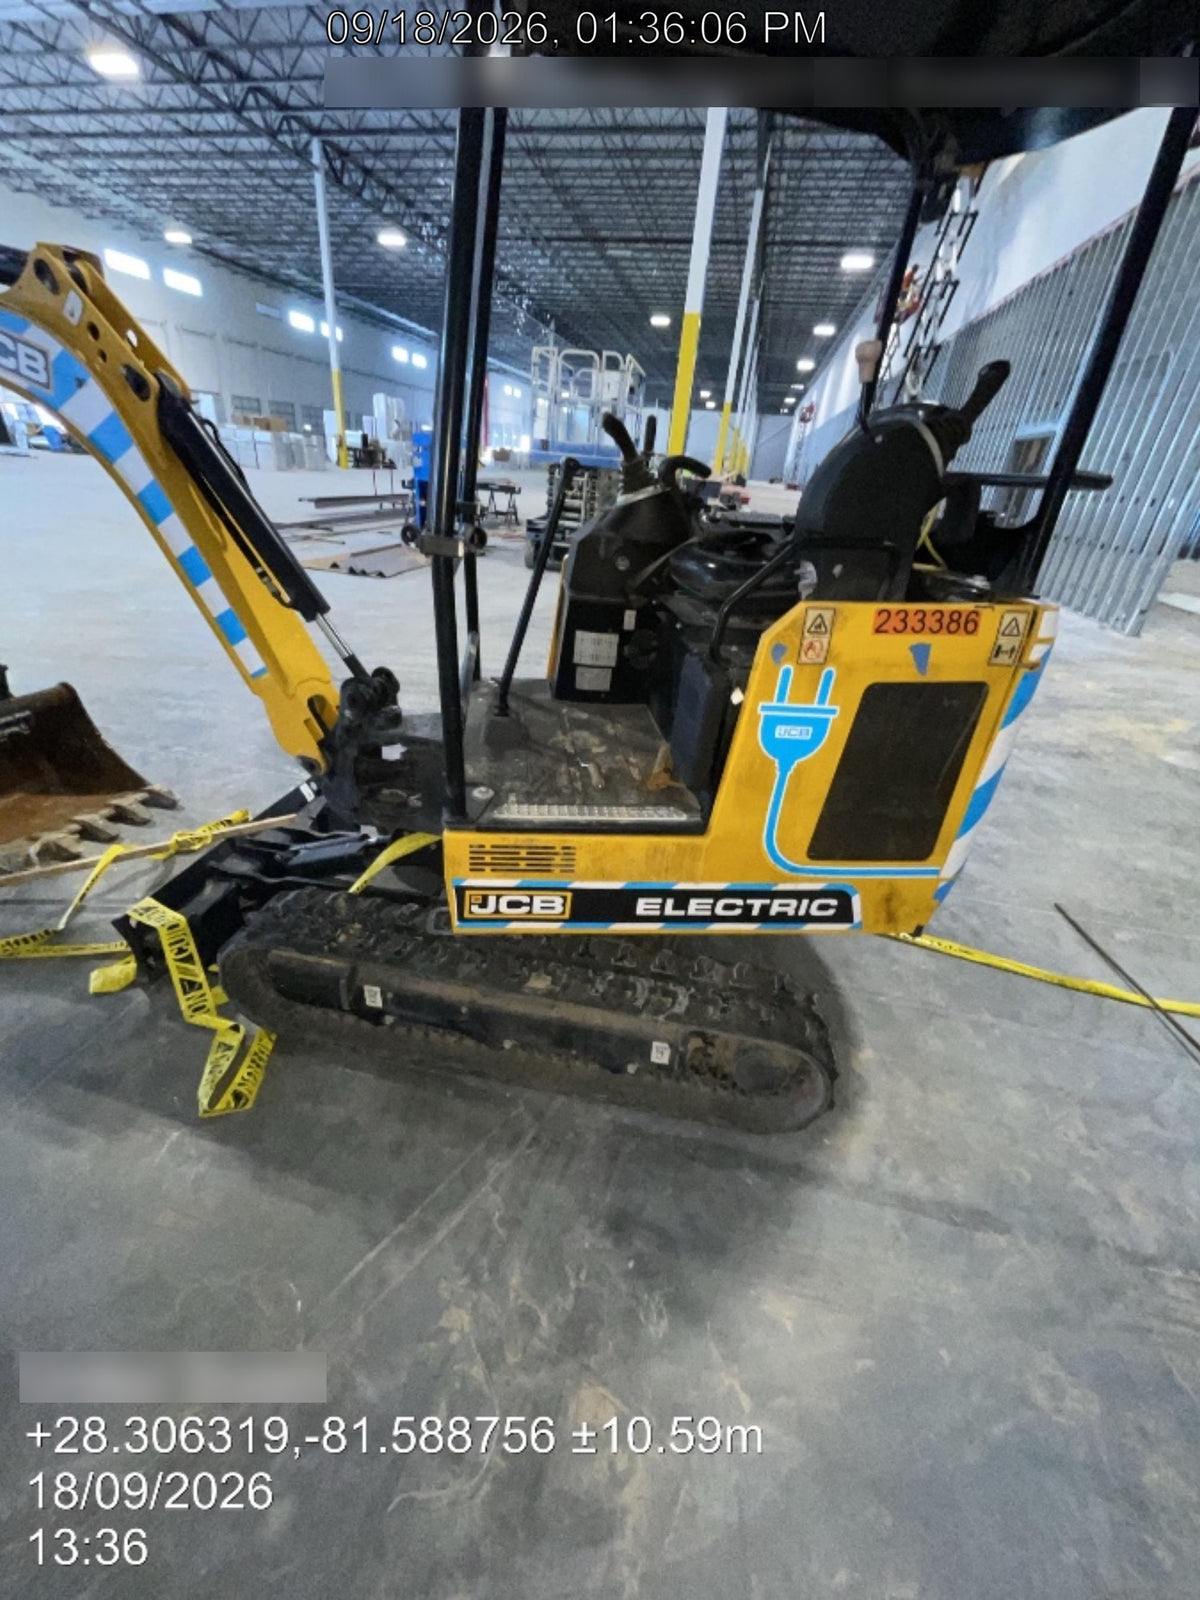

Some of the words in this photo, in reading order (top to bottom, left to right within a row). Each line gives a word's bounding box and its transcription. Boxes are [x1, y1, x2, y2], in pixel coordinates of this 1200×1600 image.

[0, 333, 48, 383] CB
[875, 609, 980, 635] 233386
[470, 895, 564, 915] JCB
[636, 897, 839, 917] ELECTRIC
